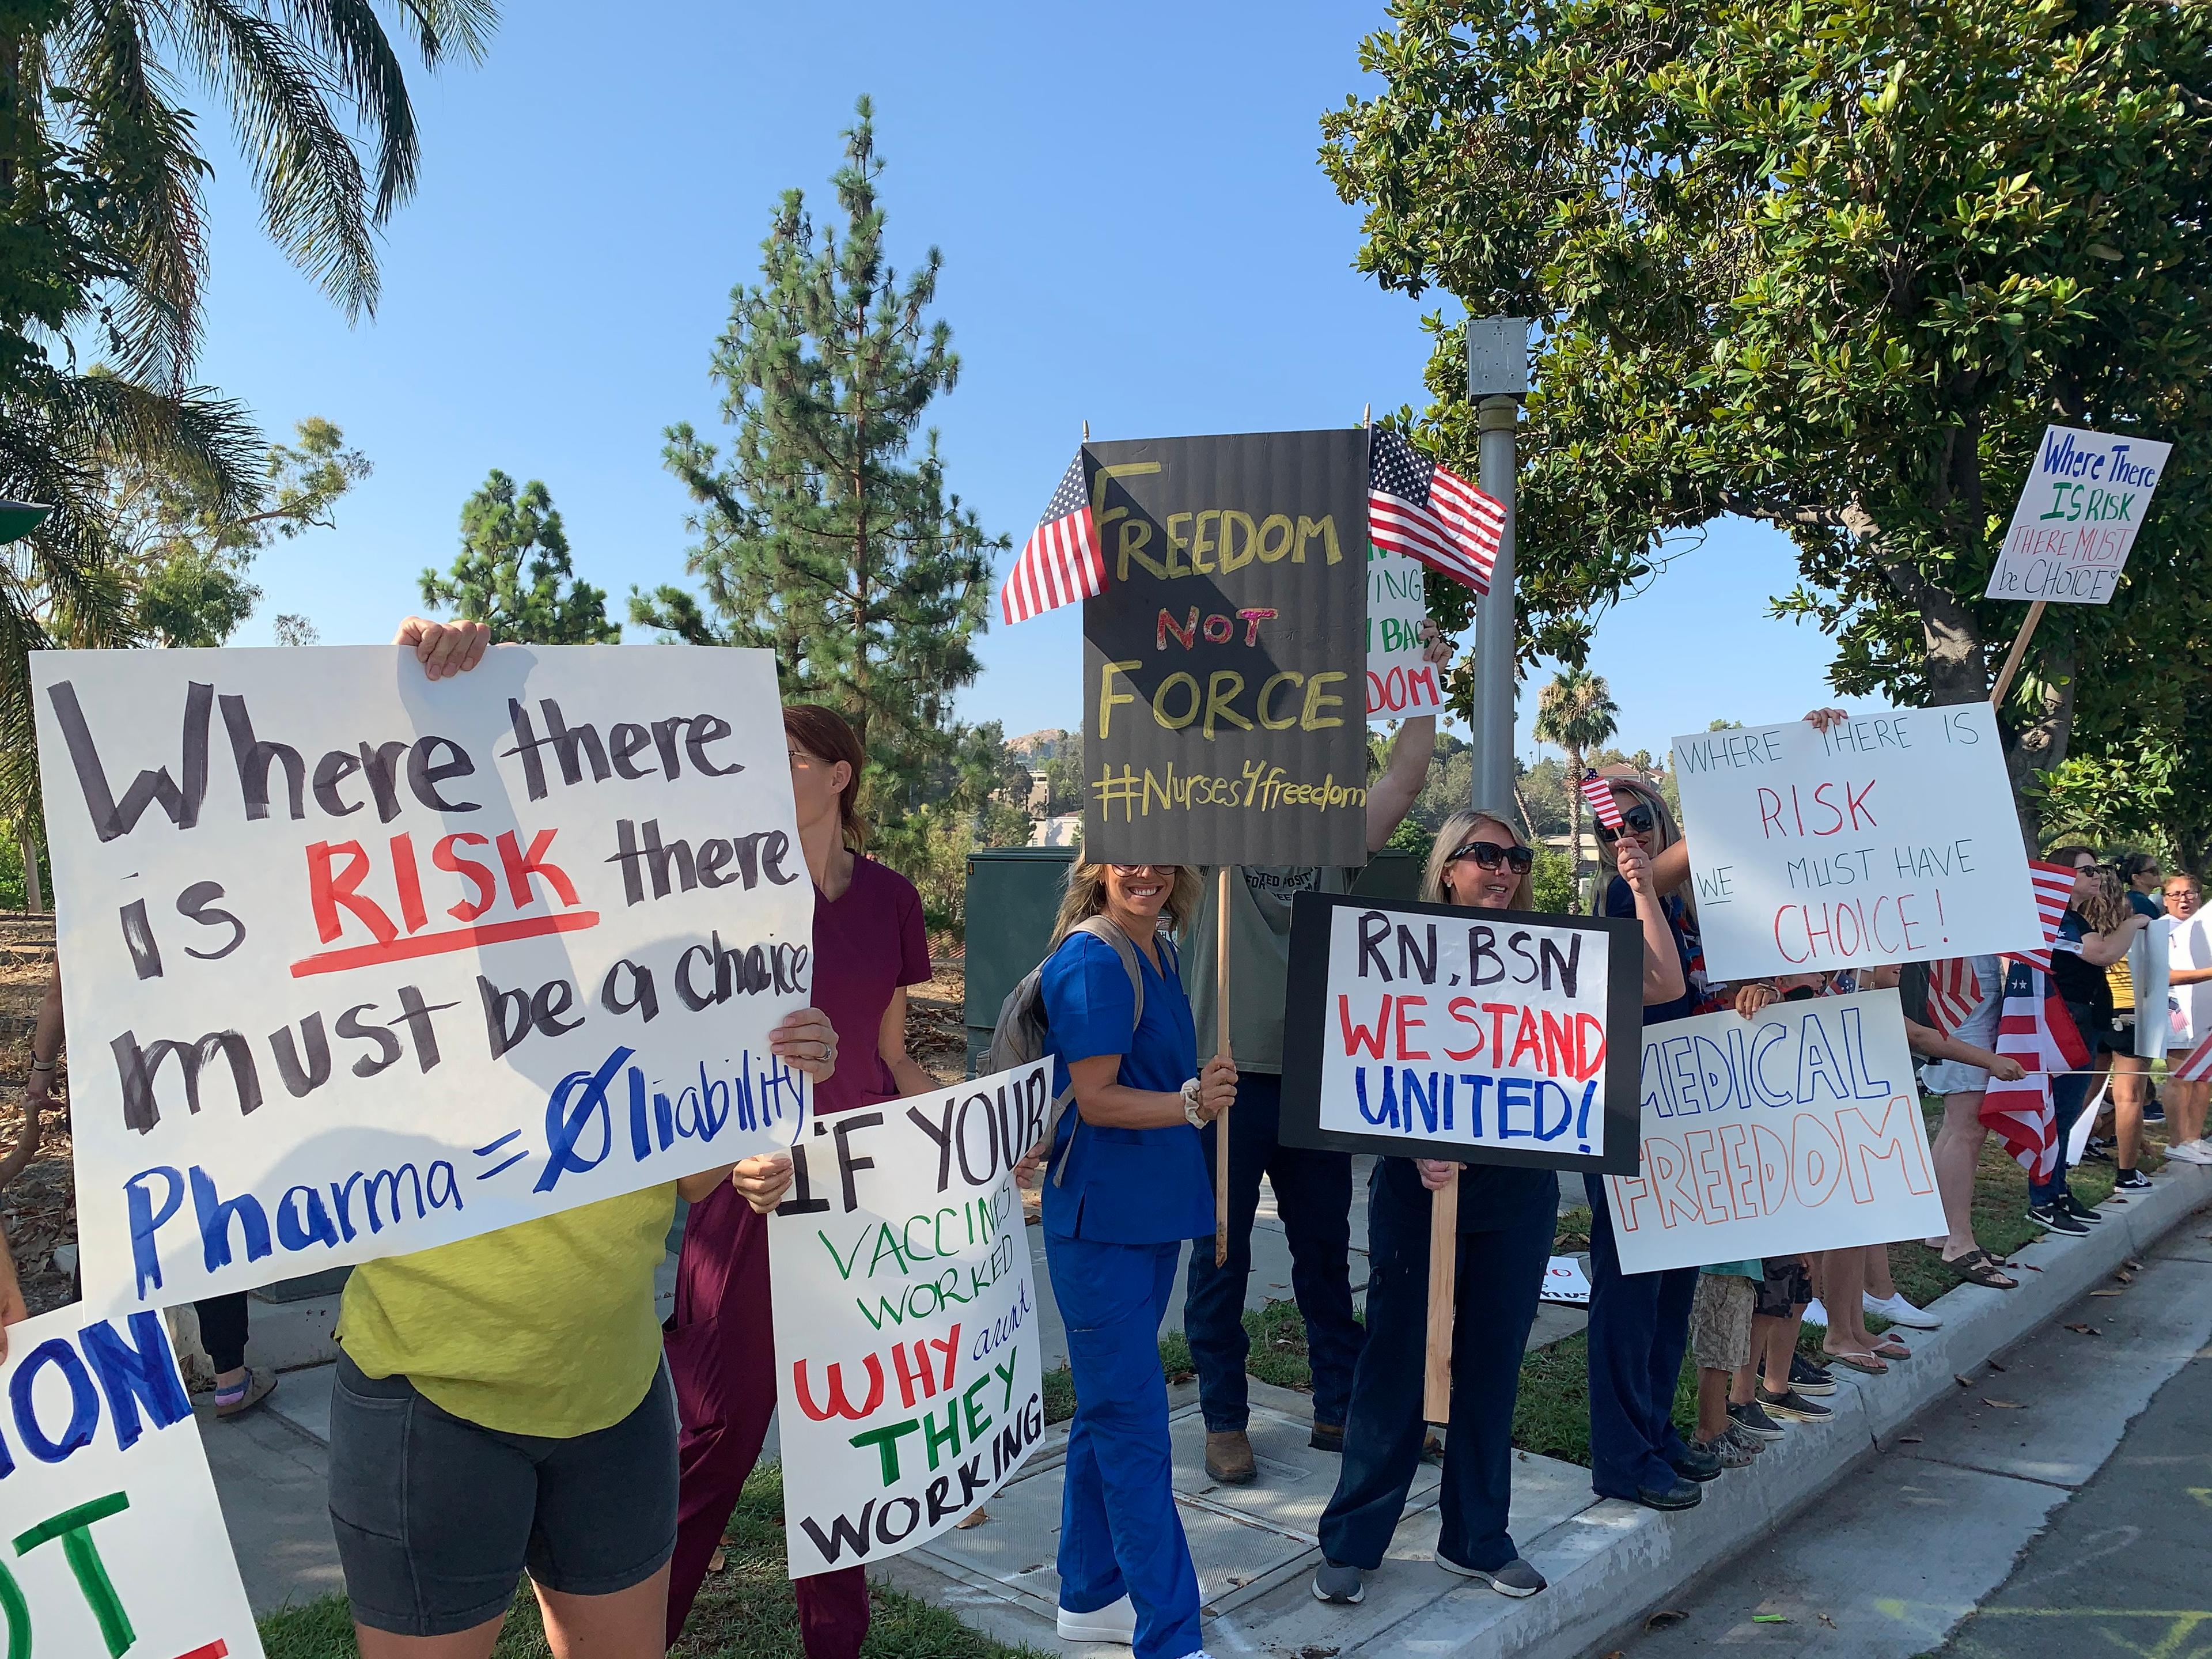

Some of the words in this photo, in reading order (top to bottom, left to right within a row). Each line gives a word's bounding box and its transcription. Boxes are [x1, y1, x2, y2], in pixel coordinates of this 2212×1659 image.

[2040, 482, 2085, 521] IS
[2085, 488, 2135, 521] RISK
[2044, 431, 2106, 480] Where
[2108, 444, 2156, 488] There
[1093, 461, 1343, 582] FREEDOM
[2012, 525, 2073, 556] THERE
[2072, 525, 2134, 562] MUST
[1998, 559, 2018, 591] be
[2024, 559, 2108, 600] CHOICE
[1156, 606, 1279, 651] NOT
[1099, 660, 1348, 741] FORCE
[1679, 730, 1783, 774] WHERE
[1813, 717, 1912, 757] THERE
[1944, 712, 1979, 745] IS
[47, 680, 483, 843] Where
[499, 697, 746, 802] there
[1092, 759, 1366, 823] #Nurses4freedom
[1757, 779, 1877, 839] RISK
[119, 872, 247, 980] is
[306, 828, 582, 949] RISK
[604, 818, 800, 907] there
[1697, 866, 1734, 899] WE
[1787, 848, 1875, 889] MUST
[1894, 839, 1975, 878] HAVE
[110, 985, 461, 1135] must
[476, 975, 585, 1060] be
[601, 959, 660, 1023] a
[1338, 994, 1431, 1060] WE
[1442, 996, 1607, 1083] STAND
[775, 1112, 884, 1217] IF
[906, 1066, 1046, 1194] YOUR
[1355, 1066, 1597, 1153] UNITED!
[123, 1159, 463, 1301] Pharma
[628, 1048, 804, 1162] liability
[1613, 1095, 1934, 1232] FREEDOM
[818, 1176, 1011, 1281] VACCINES
[857, 1234, 1013, 1331] WORKED
[0, 1309, 194, 1480] ON
[793, 1323, 961, 1422] WHY
[848, 1345, 1017, 1488] THEY
[800, 1392, 1042, 1565] WORKING
